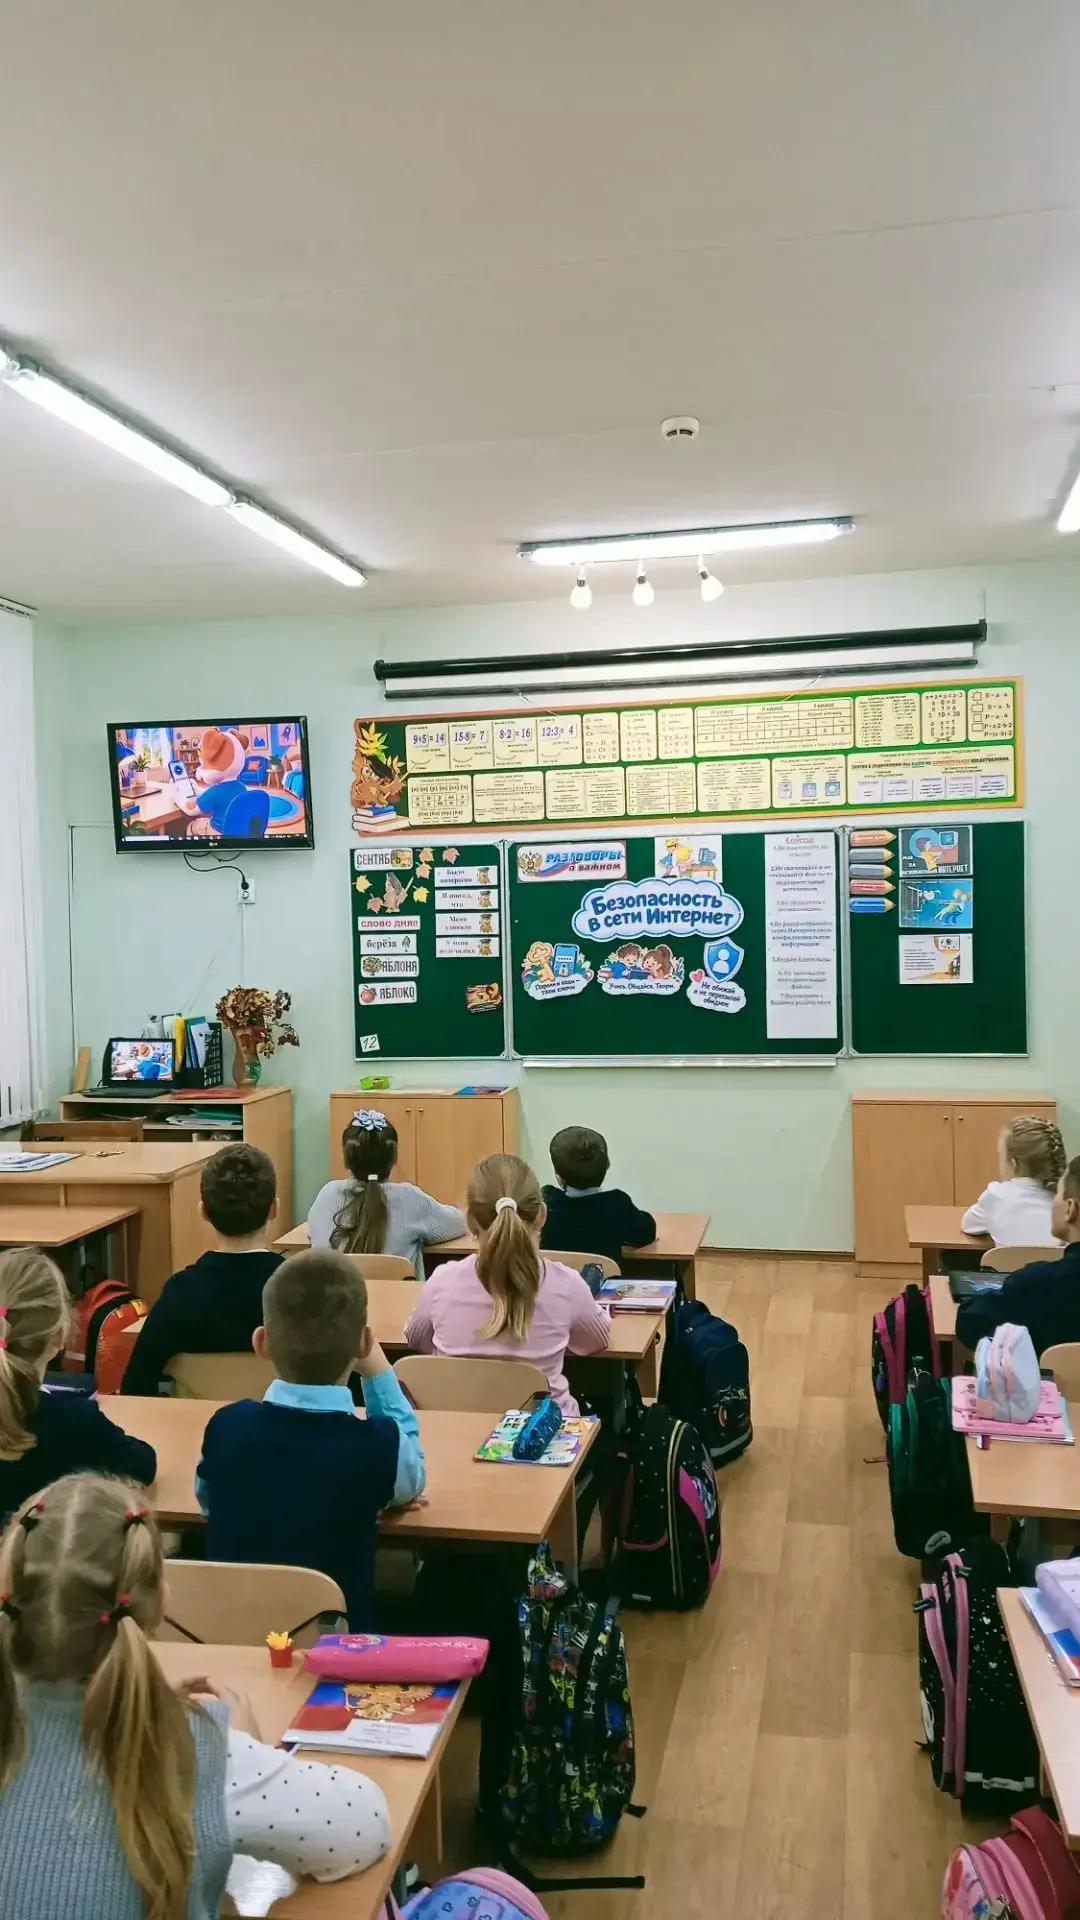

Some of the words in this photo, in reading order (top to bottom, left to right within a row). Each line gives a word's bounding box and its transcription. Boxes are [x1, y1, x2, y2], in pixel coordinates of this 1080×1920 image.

[522, 728, 531, 738] 16
[542, 726, 558, 736] 12:3
[413, 734, 427, 745] 9+5
[436, 732, 444, 743] 14
[357, 853, 402, 866] СЕНТЯБРЬ
[546, 850, 623, 862] РАЗГОВОРЫ
[578, 864, 621, 872] важном
[590, 892, 723, 916] Безопасность
[361, 920, 392, 928] СЛОВО
[394, 920, 418, 928] ДНЯ!!
[588, 916, 600, 932] в
[604, 910, 642, 928] сети
[646, 908, 734, 928] Интернет
[366, 939, 397, 950] берёза
[382, 960, 418, 972] ЯБЛОНЯ
[380, 986, 415, 1000] ЯБЛОКО
[712, 984, 736, 993] обижай
[708, 992, 740, 1001] пересылай
[704, 997, 729, 1008] обидное
[362, 1036, 377, 1050] 12
